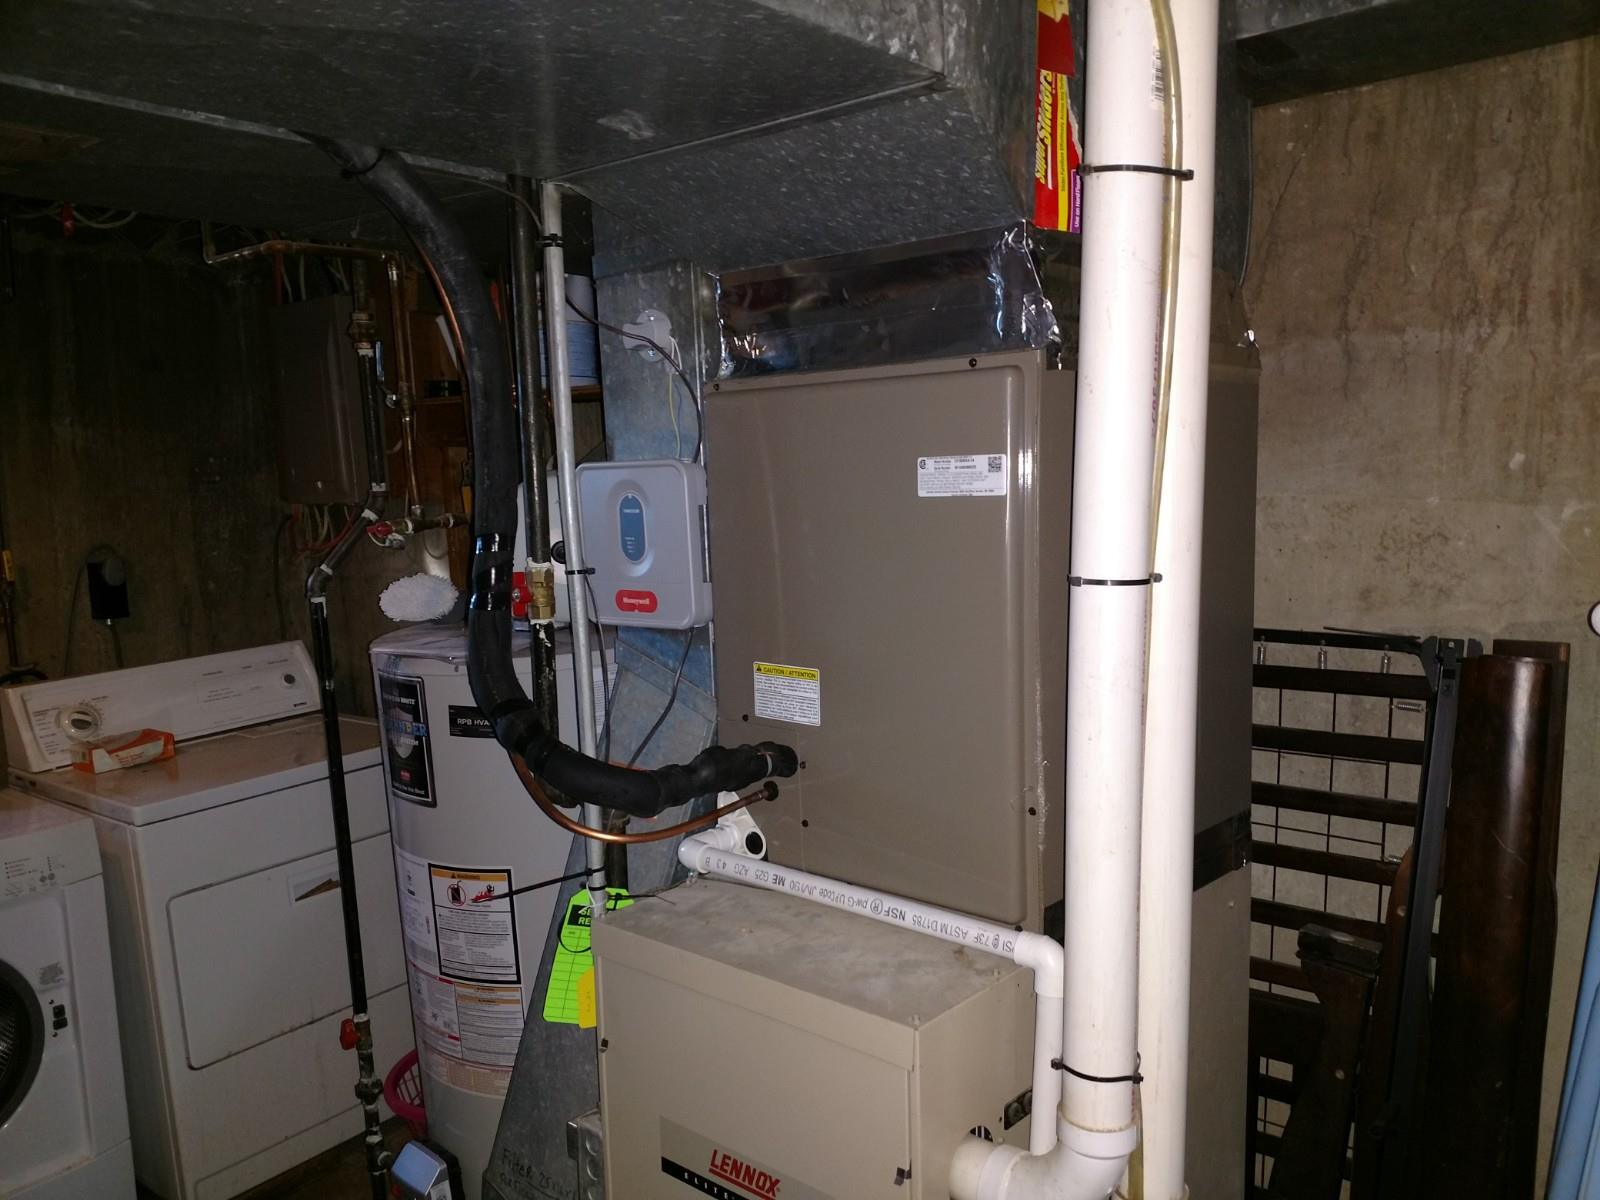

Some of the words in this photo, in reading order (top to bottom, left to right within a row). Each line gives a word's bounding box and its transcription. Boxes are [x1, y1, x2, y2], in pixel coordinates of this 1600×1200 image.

[1037, 69, 1053, 144] Sliders
[457, 718, 472, 726] RPB
[772, 874, 786, 887] ME
[912, 914, 938, 932] D1785
[940, 923, 969, 940] ASTM
[973, 932, 990, 947] 73F
[710, 1149, 781, 1197] LENNOX
[684, 1172, 729, 1200] ELITE
